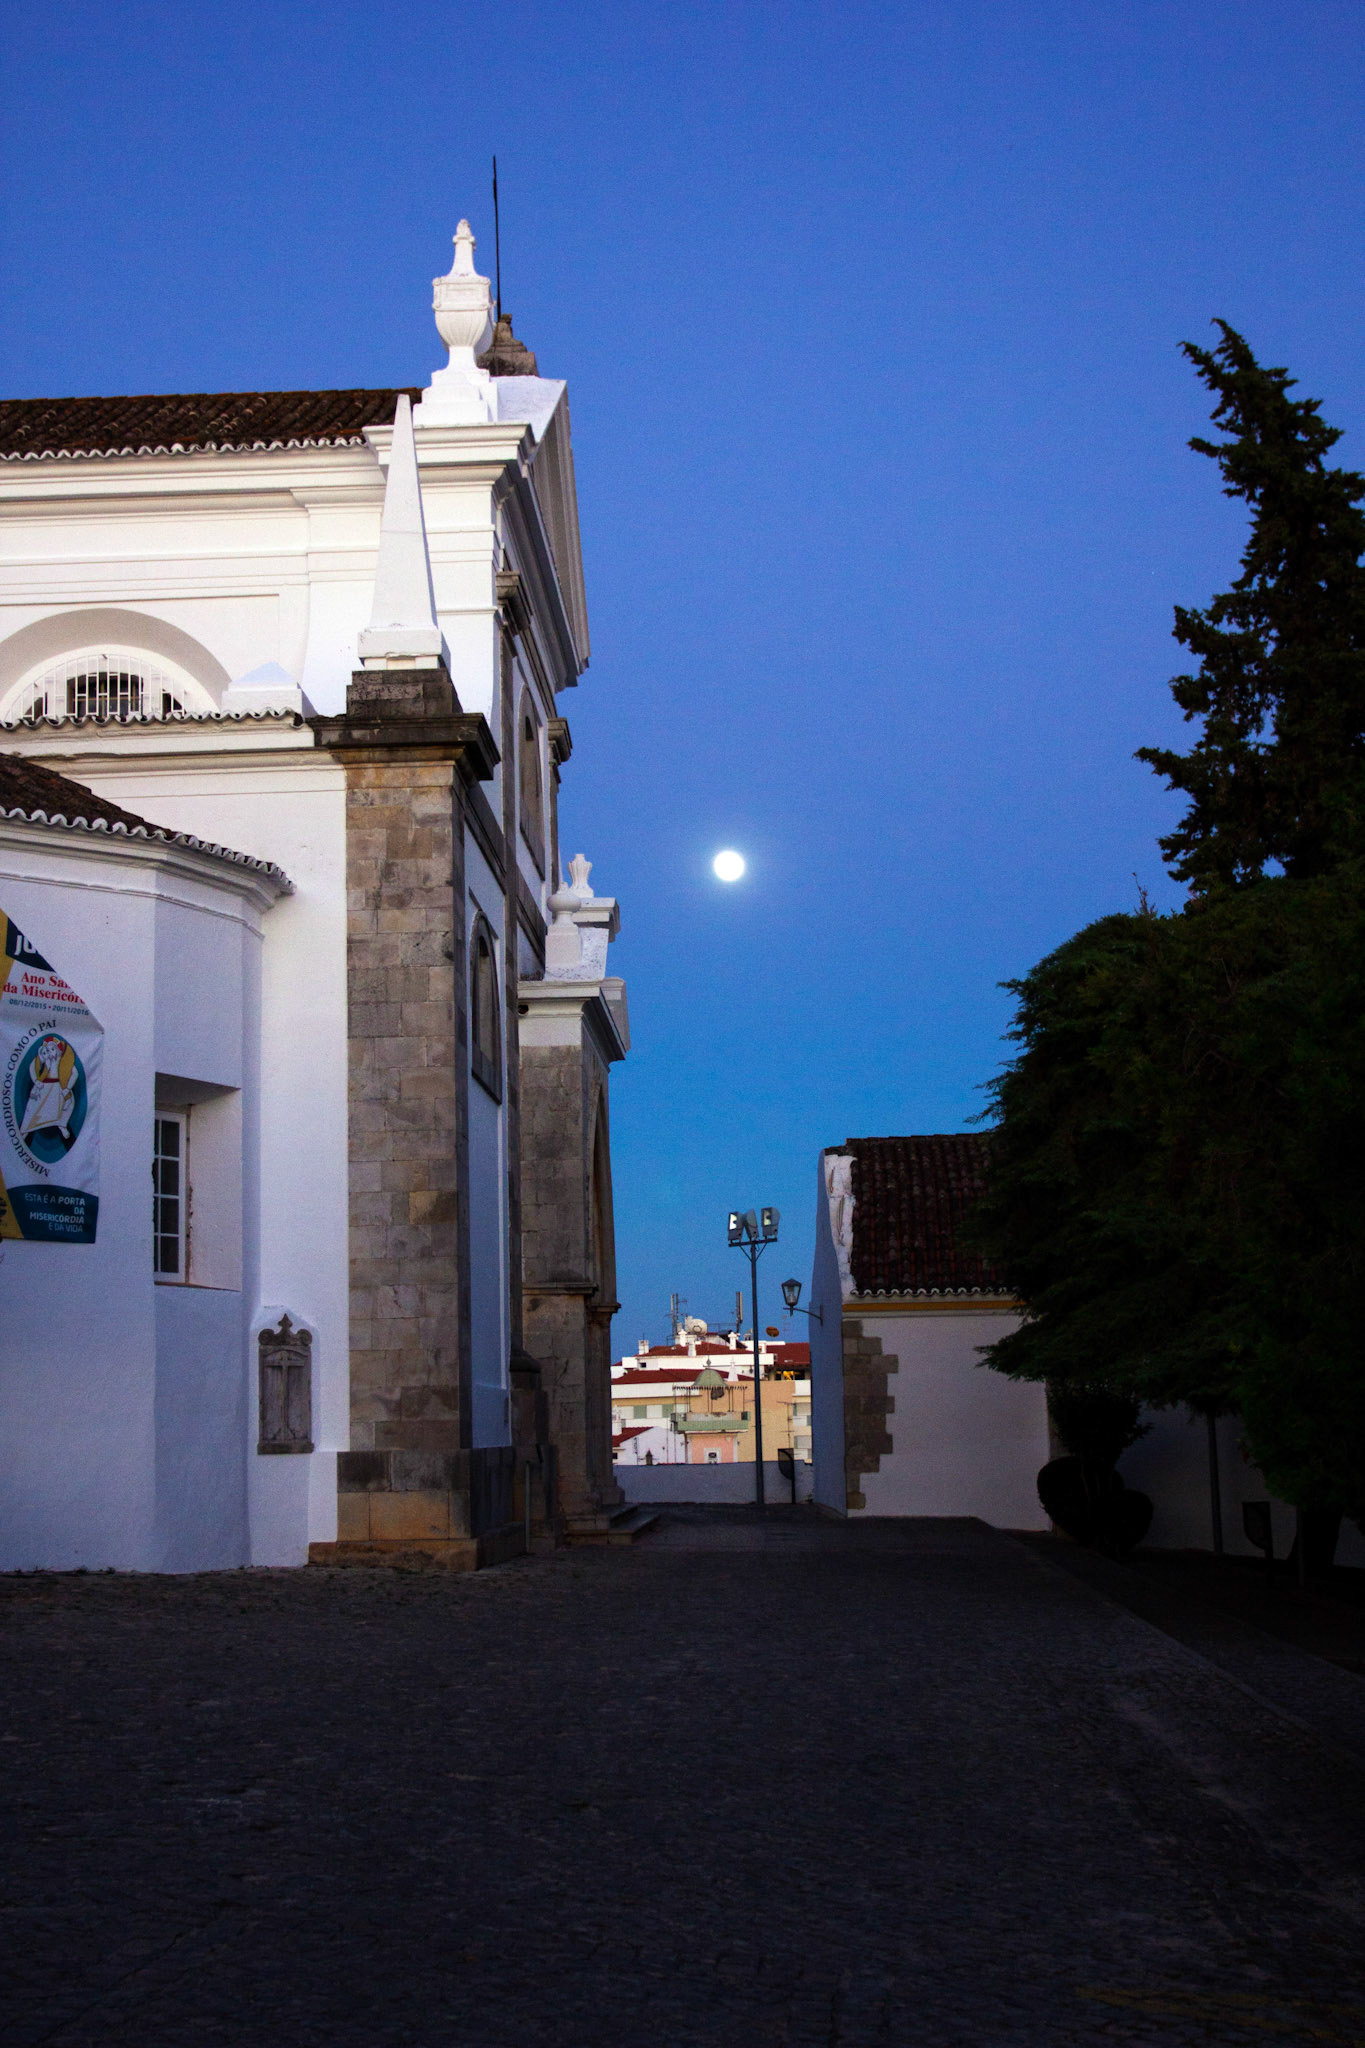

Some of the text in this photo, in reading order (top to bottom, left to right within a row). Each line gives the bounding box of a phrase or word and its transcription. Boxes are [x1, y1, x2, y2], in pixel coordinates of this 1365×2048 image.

[21, 972, 45, 985] Ano
[3, 982, 18, 994] da
[9, 998, 89, 1016] 08/12/2015 20/11/2016
[2, 1020, 57, 1177] MISERICORDIOSOS COMO O PAI
[25, 1193, 42, 1202] ESTA
[50, 1196, 56, 1204] A
[58, 1196, 85, 1206] PORTA
[74, 1207, 85, 1215] DA
[30, 1212, 85, 1224] MISERICÓRDIA
[54, 1223, 65, 1231] DA
[66, 1223, 84, 1233] VIDA
